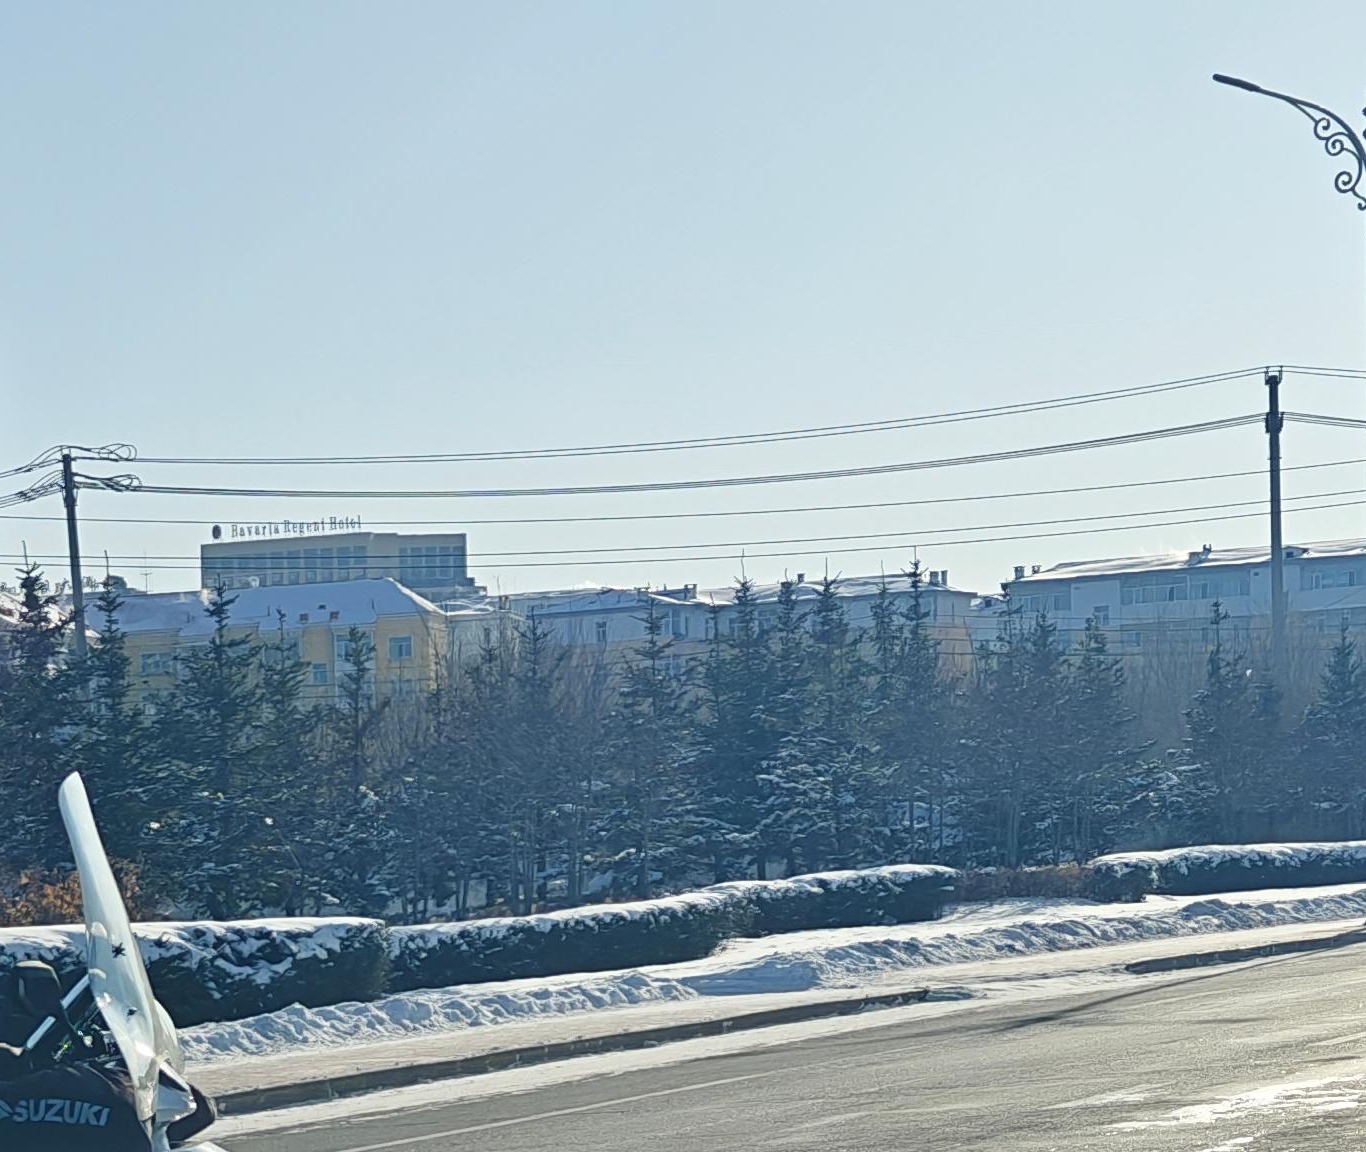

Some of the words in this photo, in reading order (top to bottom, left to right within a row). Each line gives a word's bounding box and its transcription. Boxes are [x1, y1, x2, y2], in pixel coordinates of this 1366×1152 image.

[231, 524, 280, 538] Bavaria
[283, 518, 325, 536] Regent
[329, 515, 362, 530] Hotel
[12, 1099, 111, 1127] SUZUKI
